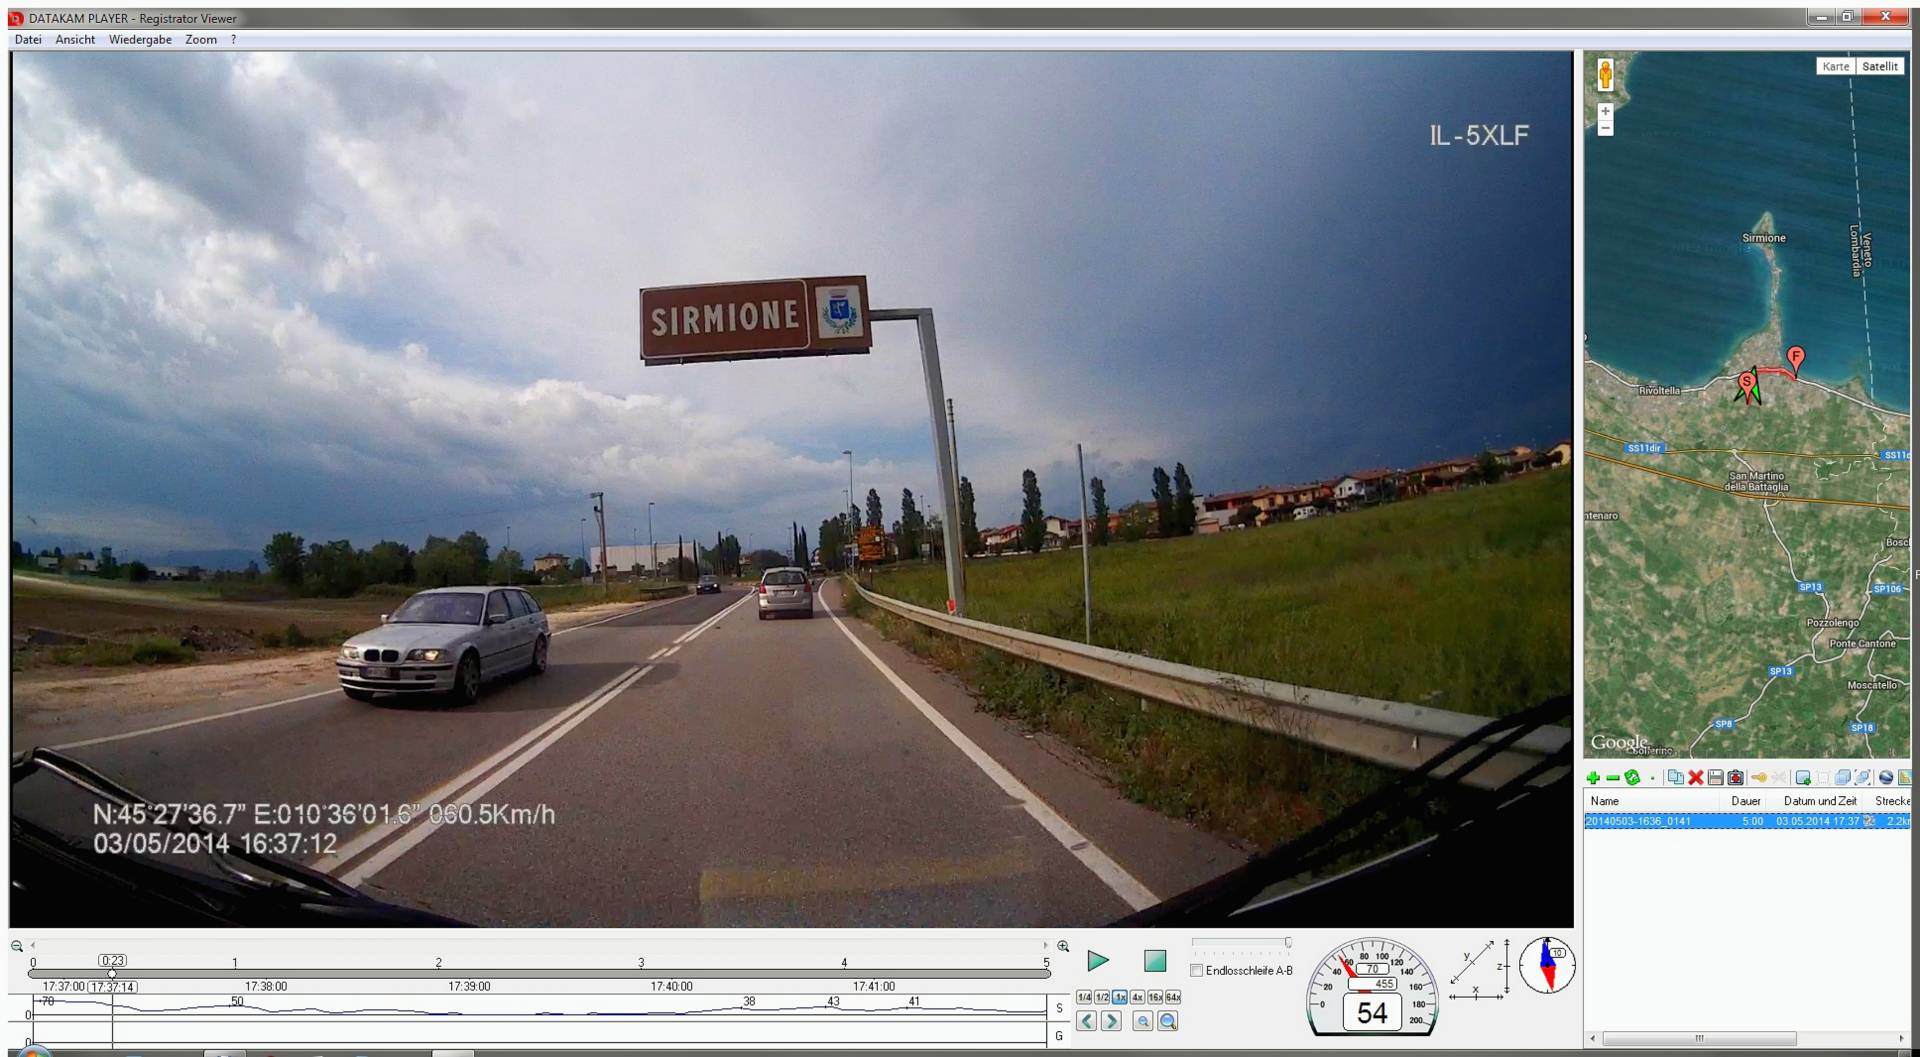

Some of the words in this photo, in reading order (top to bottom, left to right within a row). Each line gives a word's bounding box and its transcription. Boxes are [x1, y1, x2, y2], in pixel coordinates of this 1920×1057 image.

[29, 13, 84, 24] DATAKAM
[88, 13, 129, 24] PLAYER
[139, 13, 197, 26] Registrator
[200, 13, 237, 24] Viewer
[15, 34, 42, 45] Datei
[55, 34, 96, 45] Ansicht
[109, 34, 173, 47] Wiedergabe
[185, 34, 217, 45] Zoom
[231, 34, 236, 45] ?
[1823, 61, 1850, 71] Karte
[1862, 61, 1899, 71] Satellit
[1742, 232, 1787, 243] Sirmione
[1850, 224, 1862, 278] Lombardia
[1863, 232, 1873, 268] Veneto
[651, 300, 800, 337] SIRMIONE
[1792, 350, 1801, 361] F
[1742, 376, 1751, 387] S
[1638, 385, 1681, 396] Rivoltella
[1627, 444, 1661, 453] SS11dir
[1729, 471, 1747, 481] San
[1749, 471, 1785, 481] Martino
[1724, 482, 1746, 492] della
[1748, 482, 1789, 493] Battaglia
[1799, 583, 1822, 591] SP13
[1874, 585, 1902, 593] SP106
[1807, 618, 1860, 628] Pozzolengo
[1830, 639, 1855, 649] Ponte
[1856, 639, 1896, 649] Cantone
[1769, 667, 1792, 675] SP13
[1848, 680, 1897, 690] Moscatello
[1715, 720, 1733, 728] SP8
[1851, 723, 1873, 732] SP18
[1591, 734, 1648, 754] Google
[1591, 796, 1620, 806] Name
[1731, 796, 1761, 806] Dauer
[1784, 796, 1815, 806] Datum
[1818, 796, 1837, 806] und
[1838, 796, 1858, 806] Zeit
[1875, 796, 1911, 806] Strecke
[1585, 816, 1691, 828] 20140503-1636_0141
[1743, 816, 1764, 826] 5:00
[1776, 816, 1831, 826] 03.05.2014
[1834, 816, 1860, 826] 17:37
[1359, 952, 1369, 960] 80
[1376, 952, 1389, 960] 100
[1553, 949, 1562, 957] 10
[30, 957, 37, 968] 0
[102, 955, 124, 966] 0:23
[233, 957, 238, 968] 1
[435, 957, 442, 968] 2
[638, 957, 645, 968] 3
[841, 957, 848, 968] 4
[1043, 957, 1050, 968] 5
[1390, 958, 1404, 966] 120
[1206, 965, 1274, 976] Endlosschleife
[1276, 965, 1293, 976] A-B
[1332, 968, 1342, 976] 40
[1367, 964, 1379, 974] 70
[1400, 968, 1414, 976] 140
[43, 981, 85, 992] 17:37:00
[92, 982, 133, 992] 17:37:14
[245, 981, 288, 992] 17:38:00
[448, 981, 491, 992] 17:39:00
[651, 981, 693, 992] 17:40:00
[853, 981, 896, 992] 17:41:00
[1323, 983, 1333, 991] 20
[1375, 979, 1394, 989] 455
[1409, 983, 1423, 991] 160
[231, 996, 244, 1007] 50
[743, 996, 756, 1007] 38
[827, 996, 840, 1007] 43
[908, 996, 920, 1007] 41
[1078, 993, 1091, 1002] 1/4
[1096, 993, 1109, 1002] 1/2
[1116, 993, 1126, 1002] 1x
[1132, 993, 1143, 1002] 4x
[1056, 1003, 1063, 1013] S
[1412, 1000, 1426, 1008] 180
[25, 1010, 32, 1020] 0
[1357, 1001, 1388, 1024] 54
[1409, 1016, 1423, 1024] 200
[1055, 1031, 1063, 1041] G
